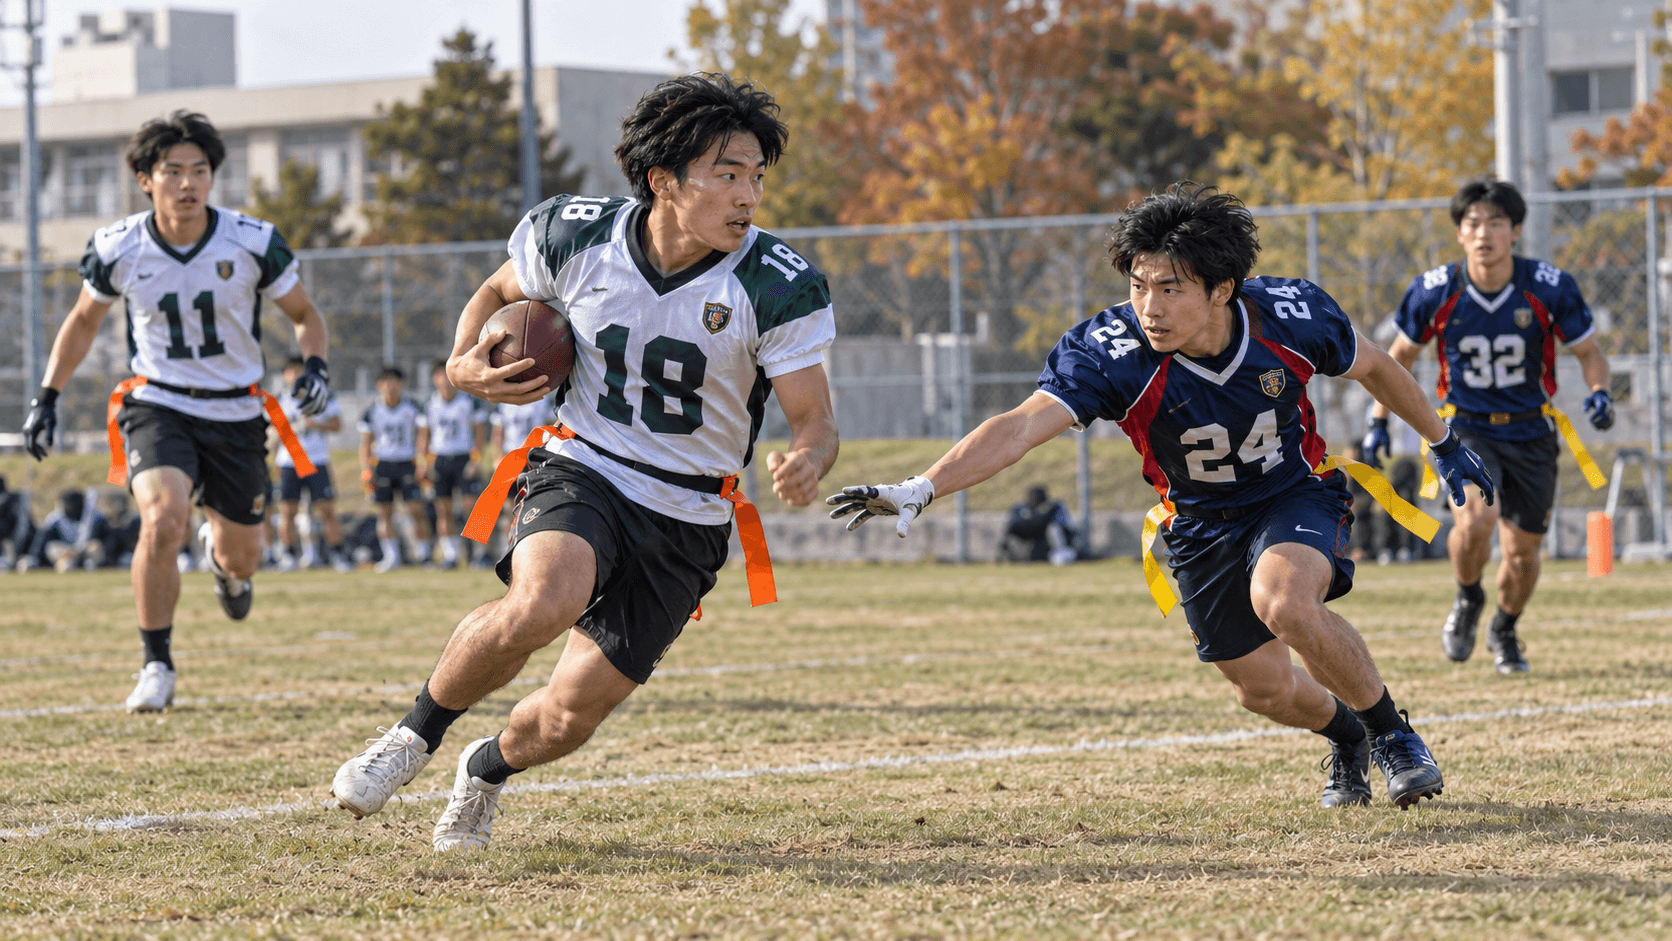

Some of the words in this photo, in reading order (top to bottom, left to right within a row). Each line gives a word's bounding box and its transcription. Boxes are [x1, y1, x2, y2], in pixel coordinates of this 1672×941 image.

[561, 196, 610, 221] 18
[761, 243, 809, 282] 18
[158, 291, 226, 359] 11
[1266, 285, 1312, 320] 24
[1090, 319, 1142, 360] 24
[1459, 334, 1526, 389] 32
[596, 323, 707, 435] 18
[1180, 409, 1284, 483] 24
